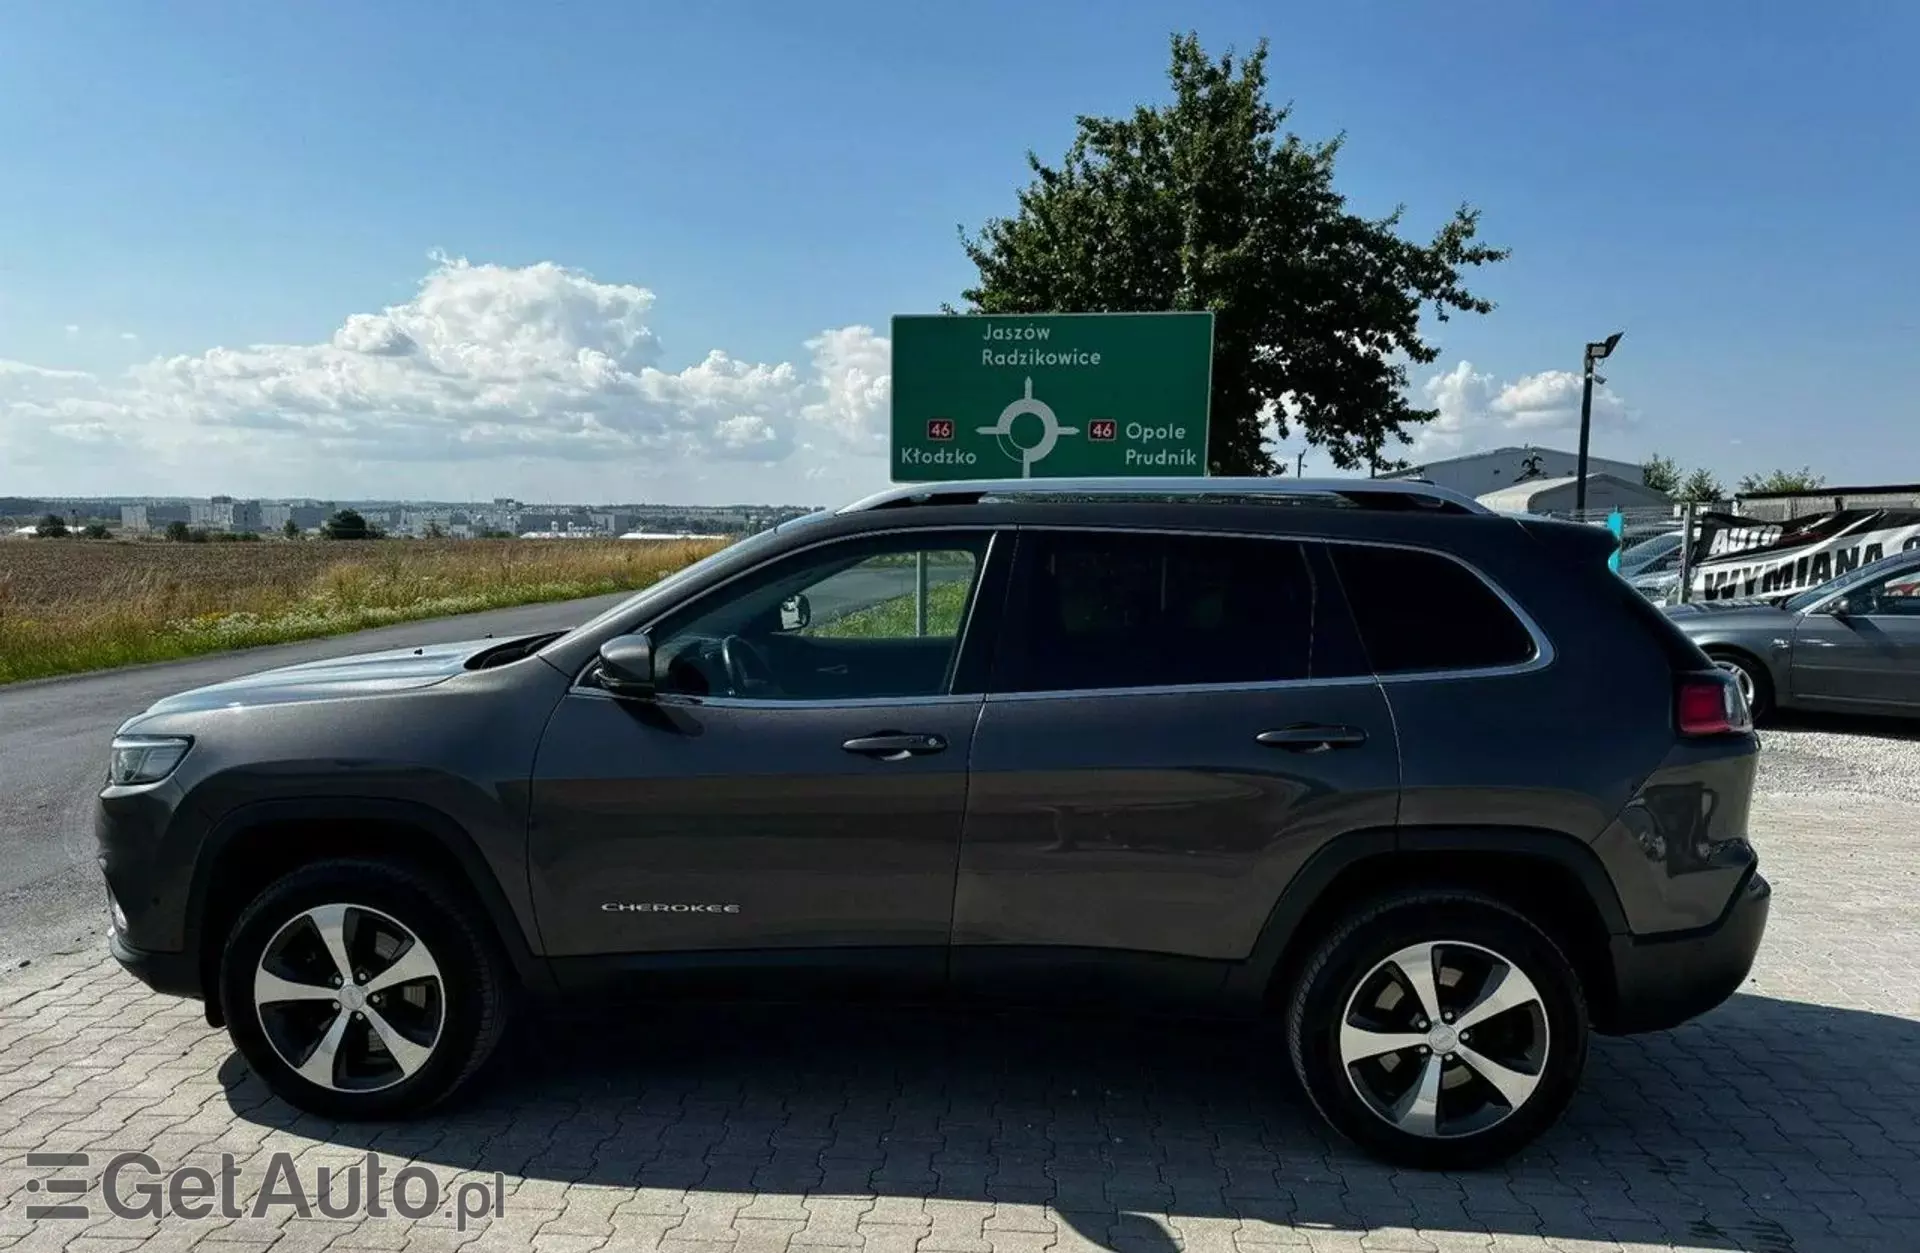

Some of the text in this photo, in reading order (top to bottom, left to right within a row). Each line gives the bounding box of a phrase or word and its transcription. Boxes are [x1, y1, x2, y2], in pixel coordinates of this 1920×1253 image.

[982, 324, 1051, 341] Jaszów
[981, 349, 1101, 366] Radzikowice
[931, 423, 951, 437] 46
[1092, 423, 1112, 437] 46
[1125, 422, 1186, 443] Opole
[901, 448, 977, 465] Kłodzko
[1124, 449, 1197, 466] Prudnik
[1709, 524, 1783, 554] AUTO
[601, 902, 741, 914] CHEROKEE
